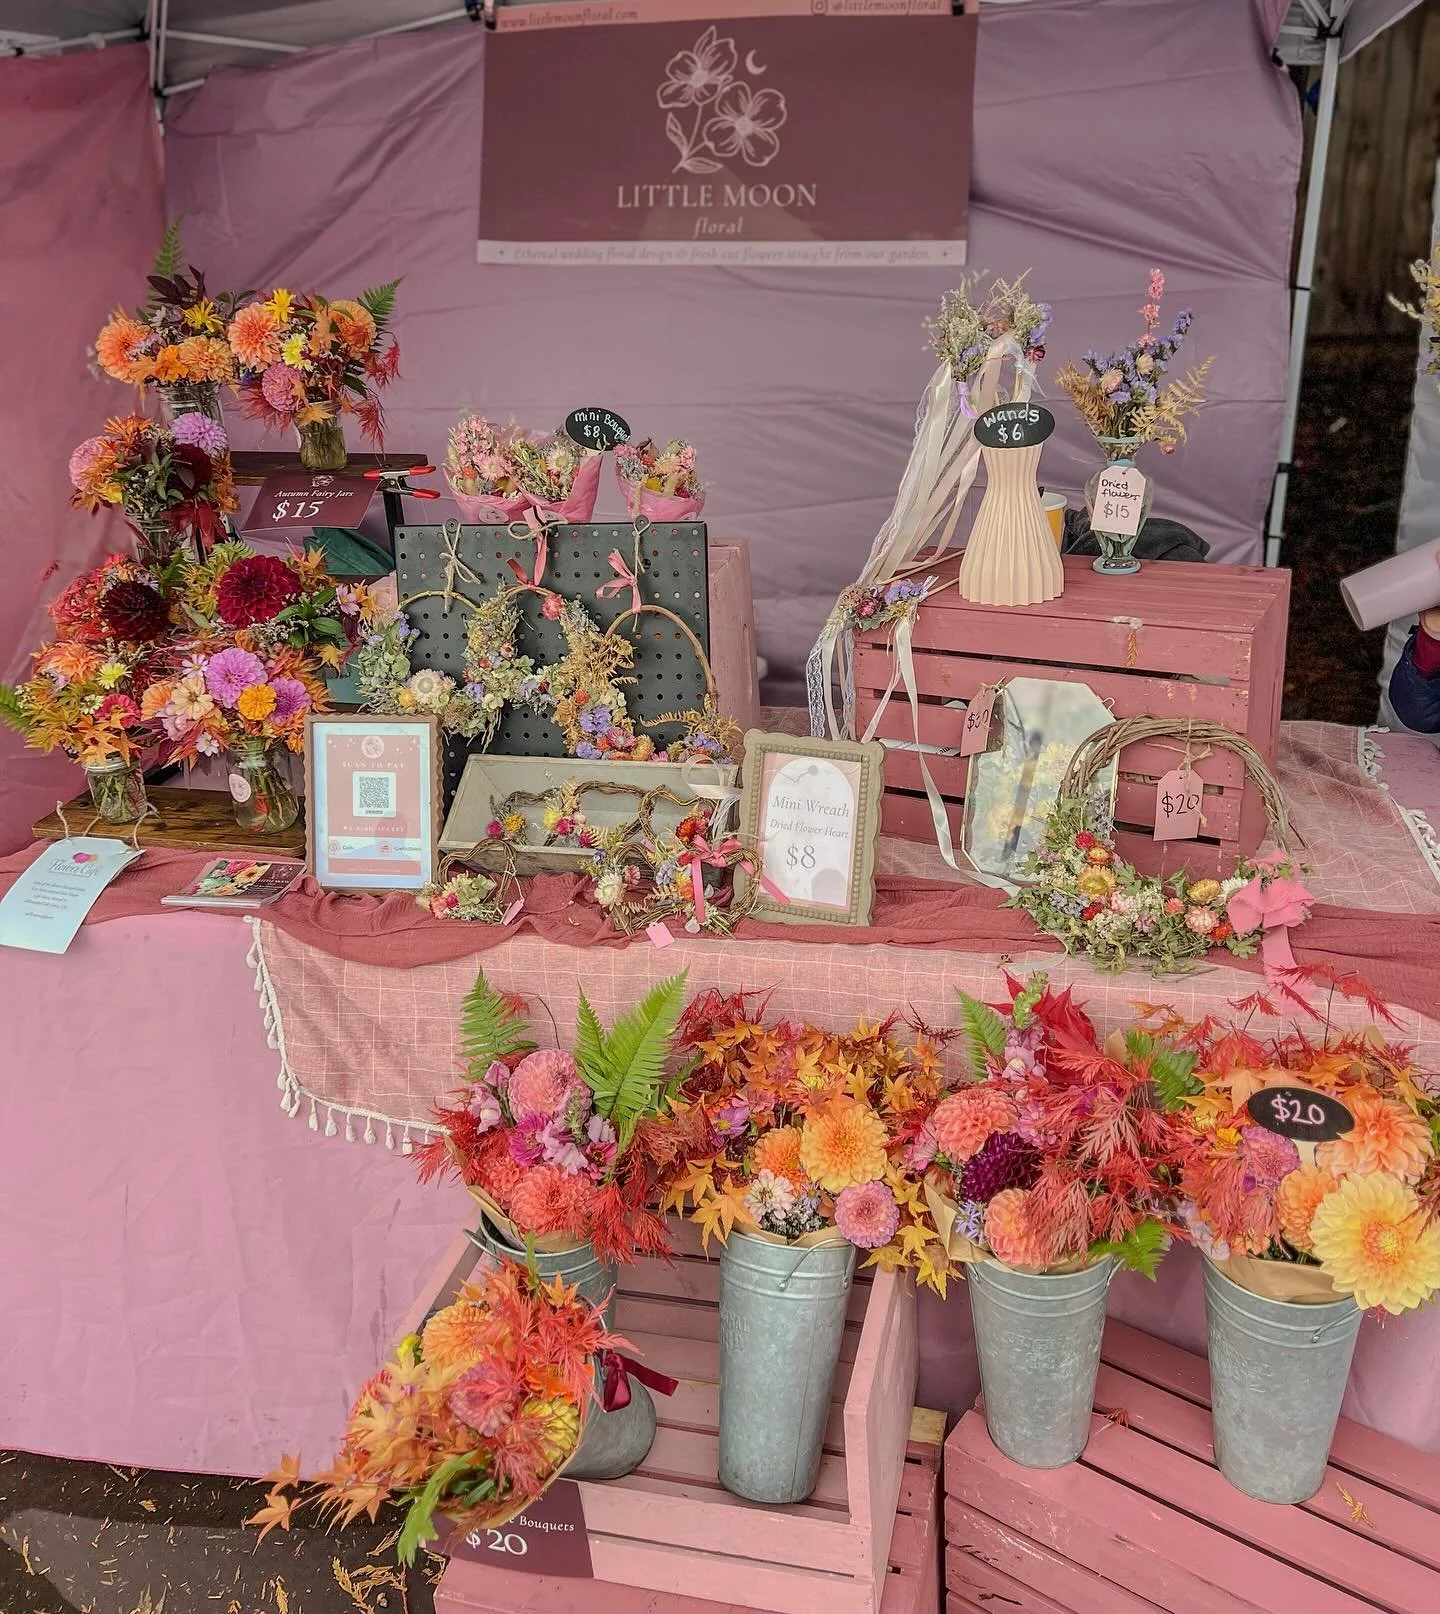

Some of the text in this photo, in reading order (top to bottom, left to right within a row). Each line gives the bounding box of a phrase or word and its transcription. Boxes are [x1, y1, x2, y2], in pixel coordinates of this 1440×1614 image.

[617, 183, 817, 209] LITTLE MOON
[692, 216, 744, 240] floral
[583, 424, 601, 438] $8
[998, 423, 1023, 444] $6
[274, 490, 354, 499] Autumn Fairy Jars
[1101, 478, 1129, 490] Dried
[272, 499, 324, 522] $15
[1103, 501, 1130, 518] $15
[772, 795, 850, 818] Mini Wreath
[1161, 791, 1200, 819] $20
[770, 818, 850, 839] Dried Flower Heart
[785, 843, 817, 870] $8
[1271, 1093, 1325, 1125] $20
[519, 1515, 575, 1532] Bouquets
